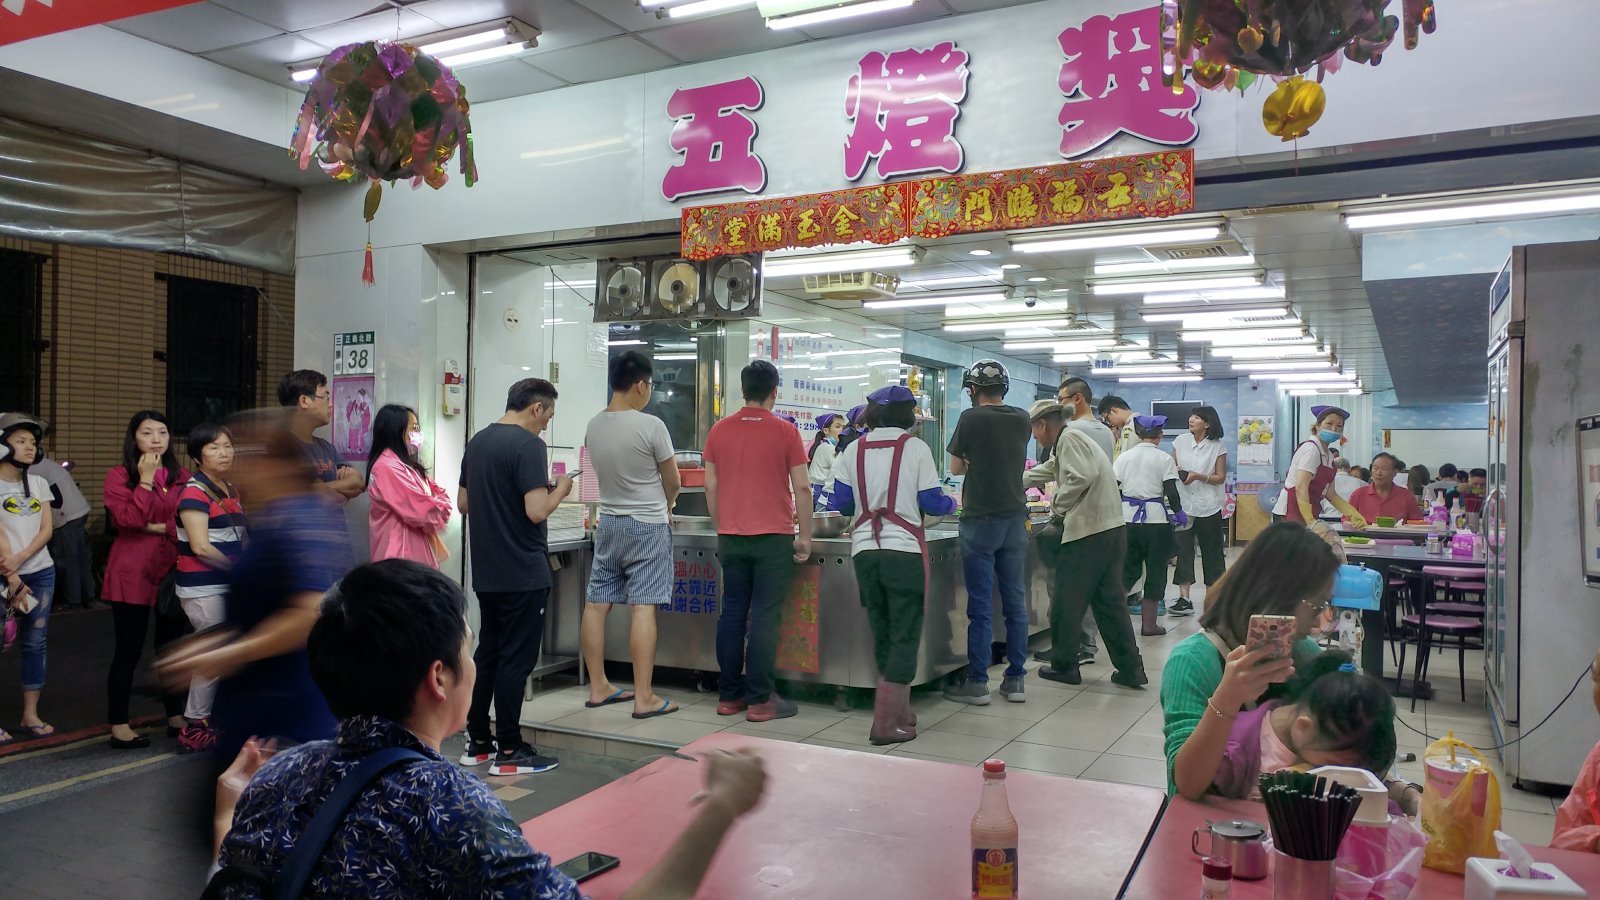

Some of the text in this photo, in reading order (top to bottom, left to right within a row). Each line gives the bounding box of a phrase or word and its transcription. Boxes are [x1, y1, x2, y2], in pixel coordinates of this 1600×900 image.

[661, 5, 1200, 202] 五燈獎
[345, 333, 371, 344] 正義北路
[348, 349, 368, 369] 38
[674, 561, 717, 579] 溫小心
[674, 578, 717, 597] 太靠近
